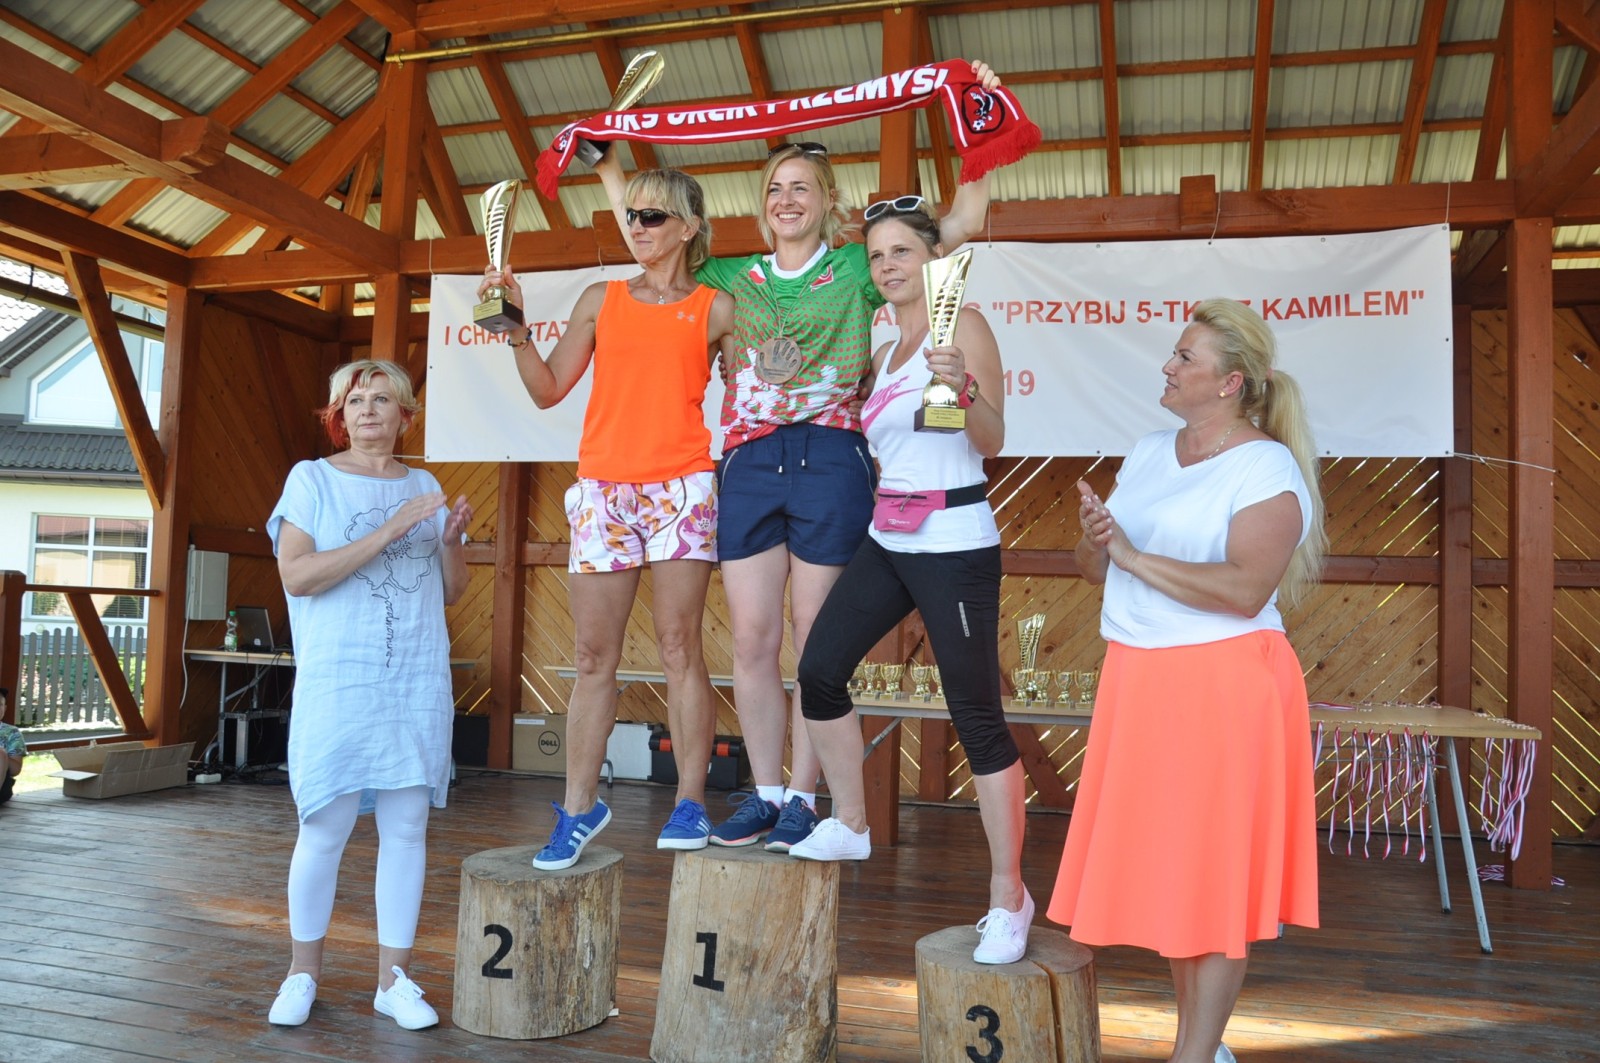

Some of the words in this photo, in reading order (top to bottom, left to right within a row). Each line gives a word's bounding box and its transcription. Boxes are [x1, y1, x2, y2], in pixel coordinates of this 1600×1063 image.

[444, 325, 451, 346] I
[991, 300, 1127, 325] "PRZYBIJ
[1262, 289, 1425, 321] KAMILEM"
[1003, 370, 1035, 396] 19
[540, 739, 558, 747] DELL
[481, 923, 514, 980] 2
[692, 932, 726, 992] 1
[965, 1004, 1003, 1063] 3
